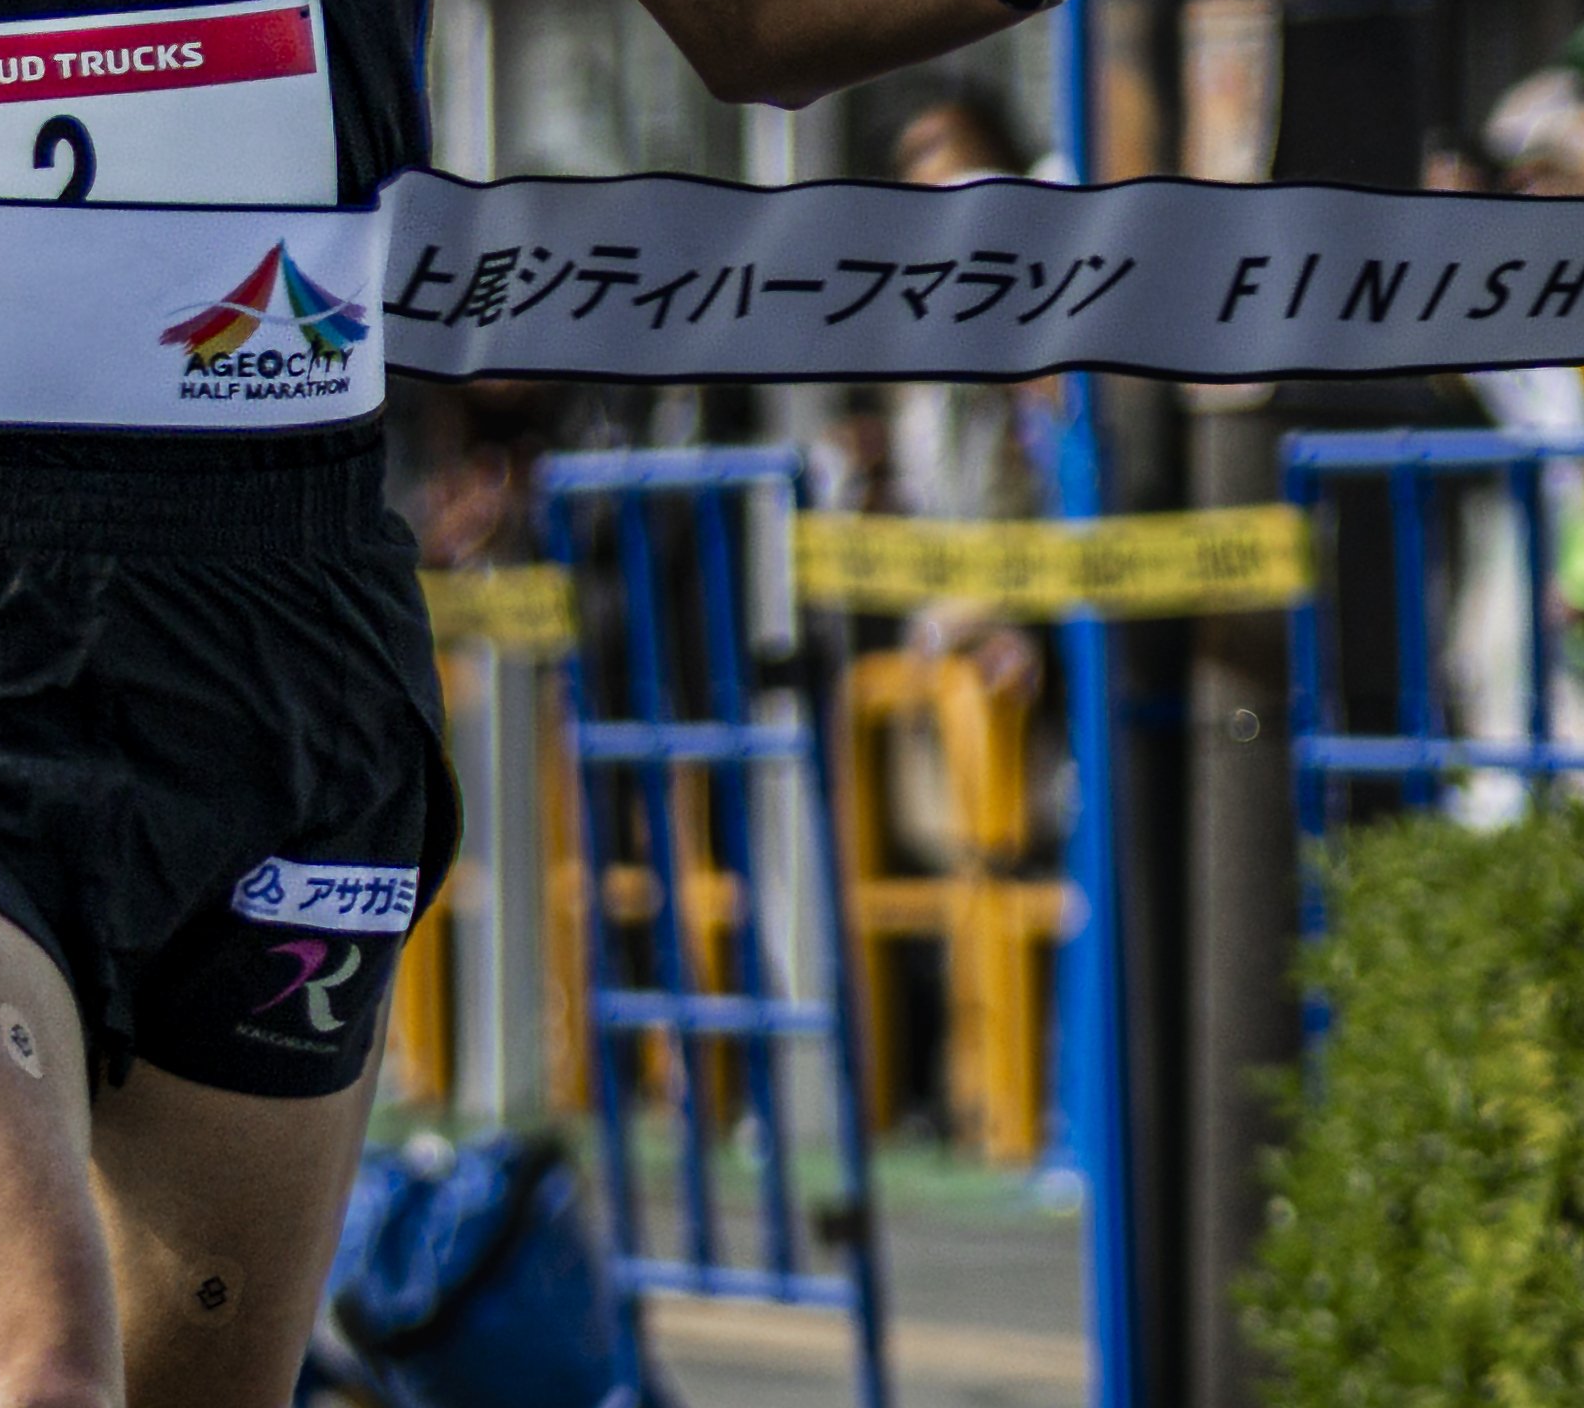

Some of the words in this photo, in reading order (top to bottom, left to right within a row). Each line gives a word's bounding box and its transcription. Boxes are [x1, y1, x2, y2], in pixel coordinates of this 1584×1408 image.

[53, 42, 204, 80] TRUCKS
[383, 245, 1136, 329] 上尾シティハーフマラソン
[182, 381, 240, 400] HALF
[245, 376, 352, 400] MARATHON
[298, 876, 416, 916] アサガミ
